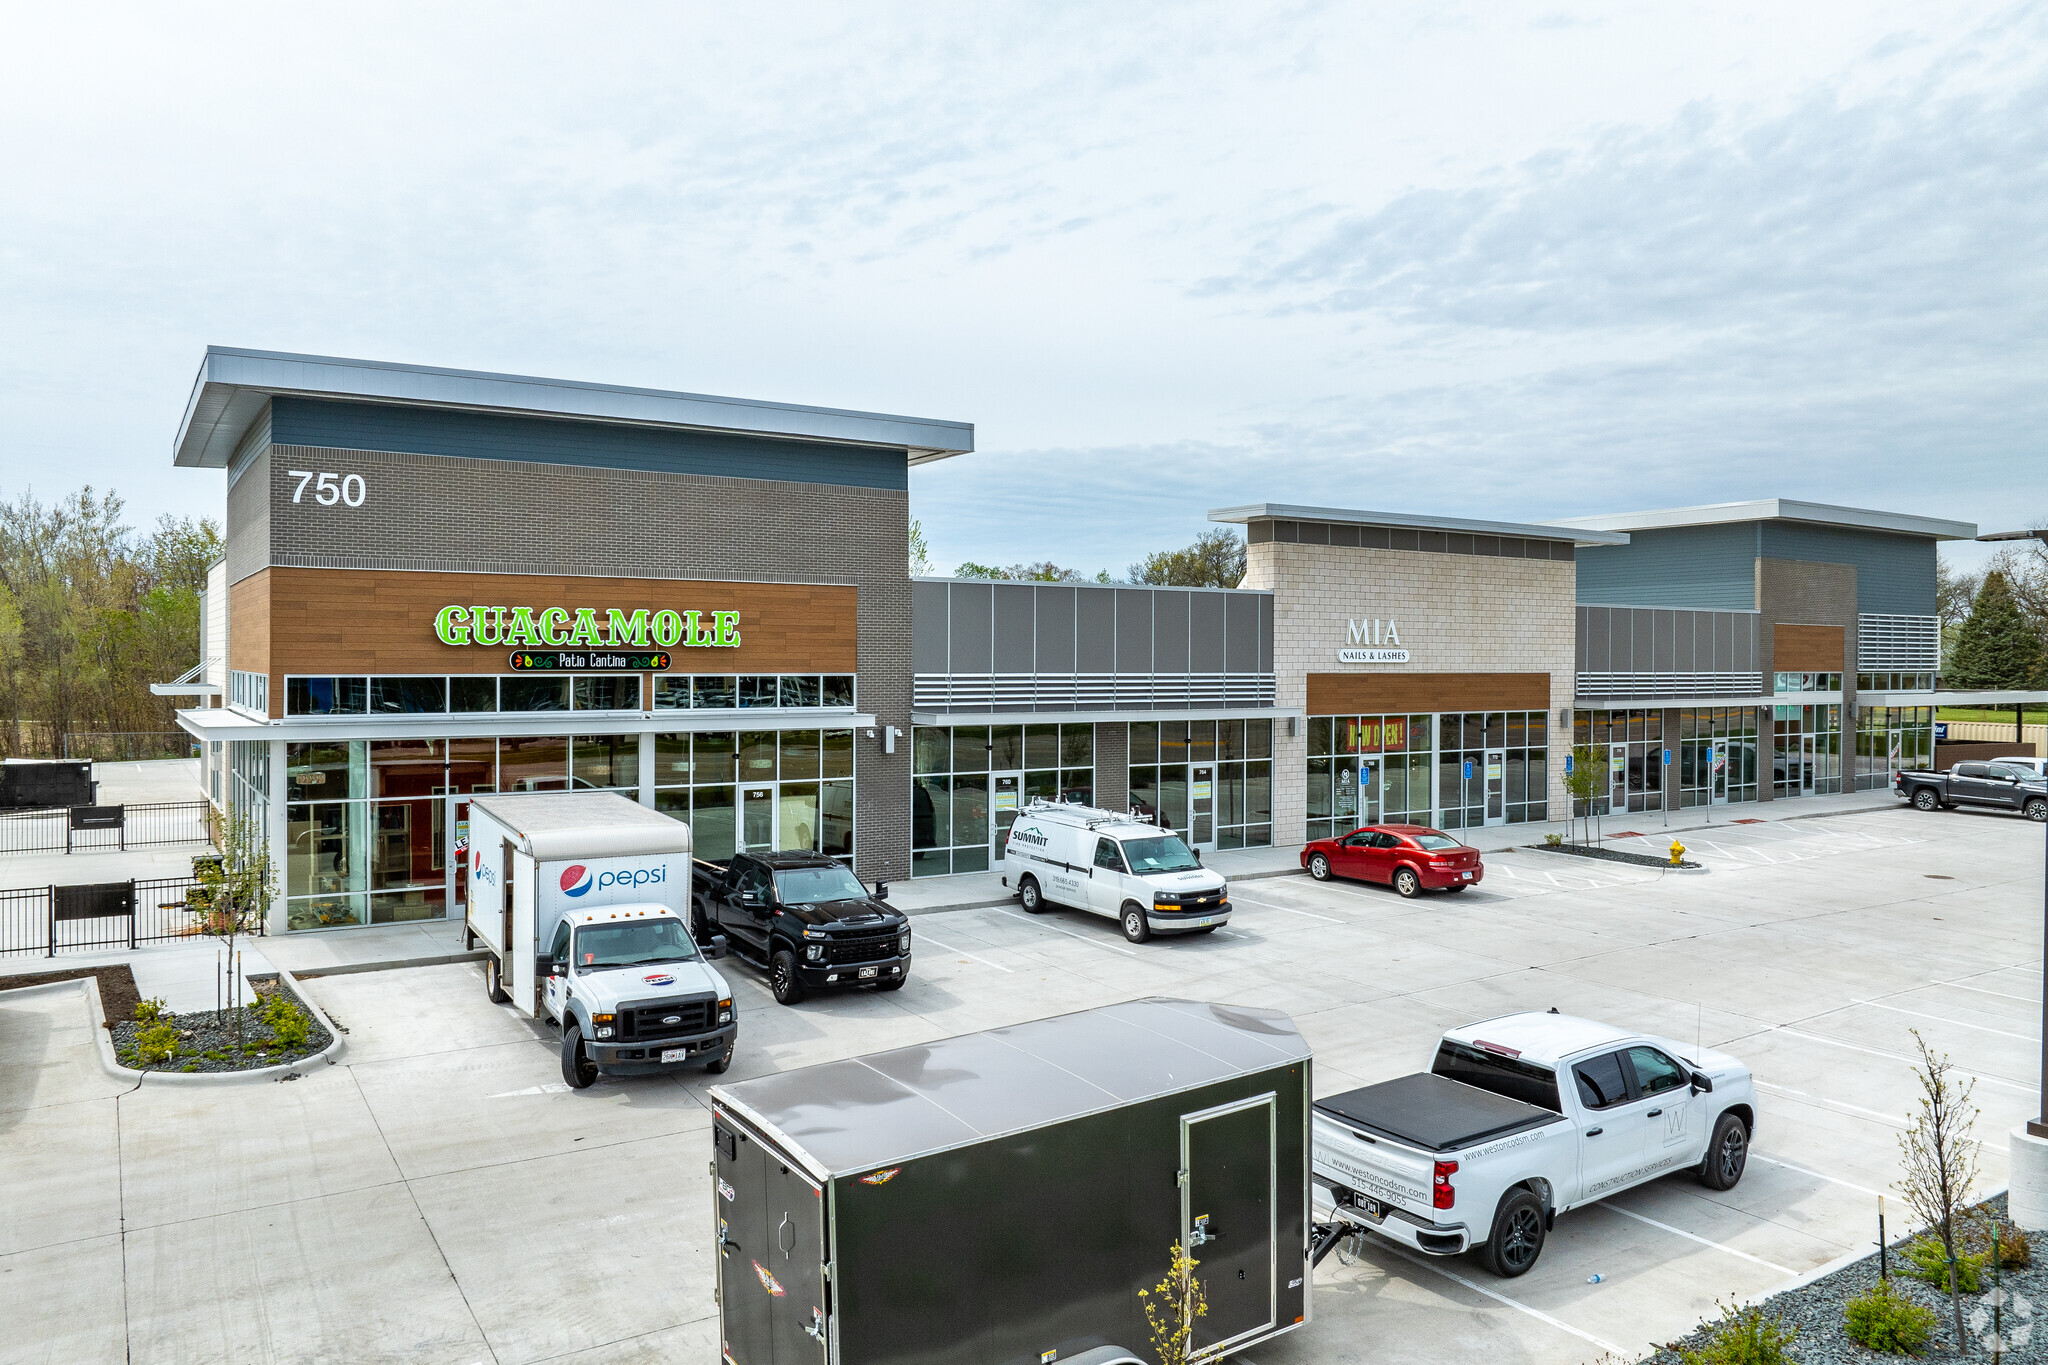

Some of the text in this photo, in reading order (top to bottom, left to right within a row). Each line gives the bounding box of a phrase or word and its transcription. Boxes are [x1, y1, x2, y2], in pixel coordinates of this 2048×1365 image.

[288, 470, 367, 507] 750
[433, 605, 741, 648] GUACAMOLE
[1346, 618, 1400, 645] MIA
[559, 653, 626, 668] Patio Cantina
[1343, 651, 1406, 660] NAILS & LASHES
[1349, 724, 1371, 747] NW
[1012, 830, 1049, 847] SUMMIT
[481, 863, 497, 888] pepsi
[598, 864, 667, 891] pepsi
[1463, 1130, 1545, 1161] www.westoncodsm.com
[1332, 1158, 1429, 1201] www.westoncodsm.com
[1589, 1156, 1673, 1193] CONSTRUCTION SERVICES
[1351, 1175, 1408, 1207] 515-446-9055
